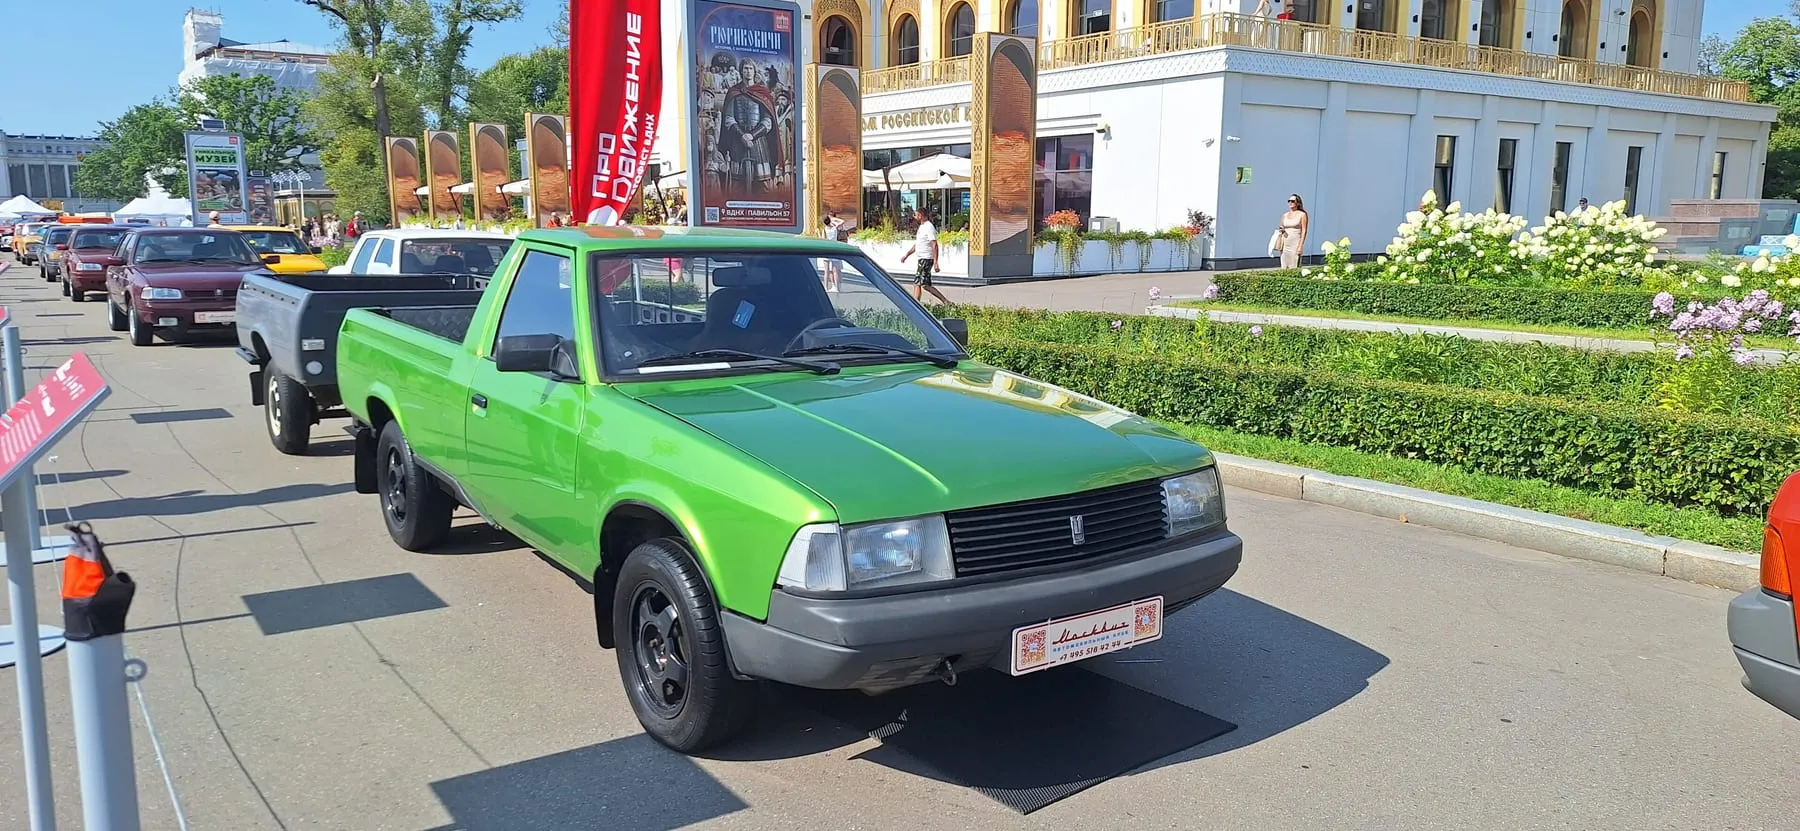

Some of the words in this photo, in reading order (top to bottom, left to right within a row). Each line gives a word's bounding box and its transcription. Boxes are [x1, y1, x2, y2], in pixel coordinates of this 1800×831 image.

[711, 25, 780, 49] РЮРИКОВИЧИ
[612, 12, 642, 203] ДВИЖЕНИЕ
[861, 116, 878, 132] ОМ
[881, 103, 960, 129] РОССИЙСКОЙ
[644, 113, 655, 146] ВДНХ
[195, 154, 237, 163] МУЗЕЙ
[592, 133, 616, 198] ПРО
[1070, 649, 1085, 659] 495
[1100, 643, 1110, 651] 42
[1112, 640, 1121, 648] 44
